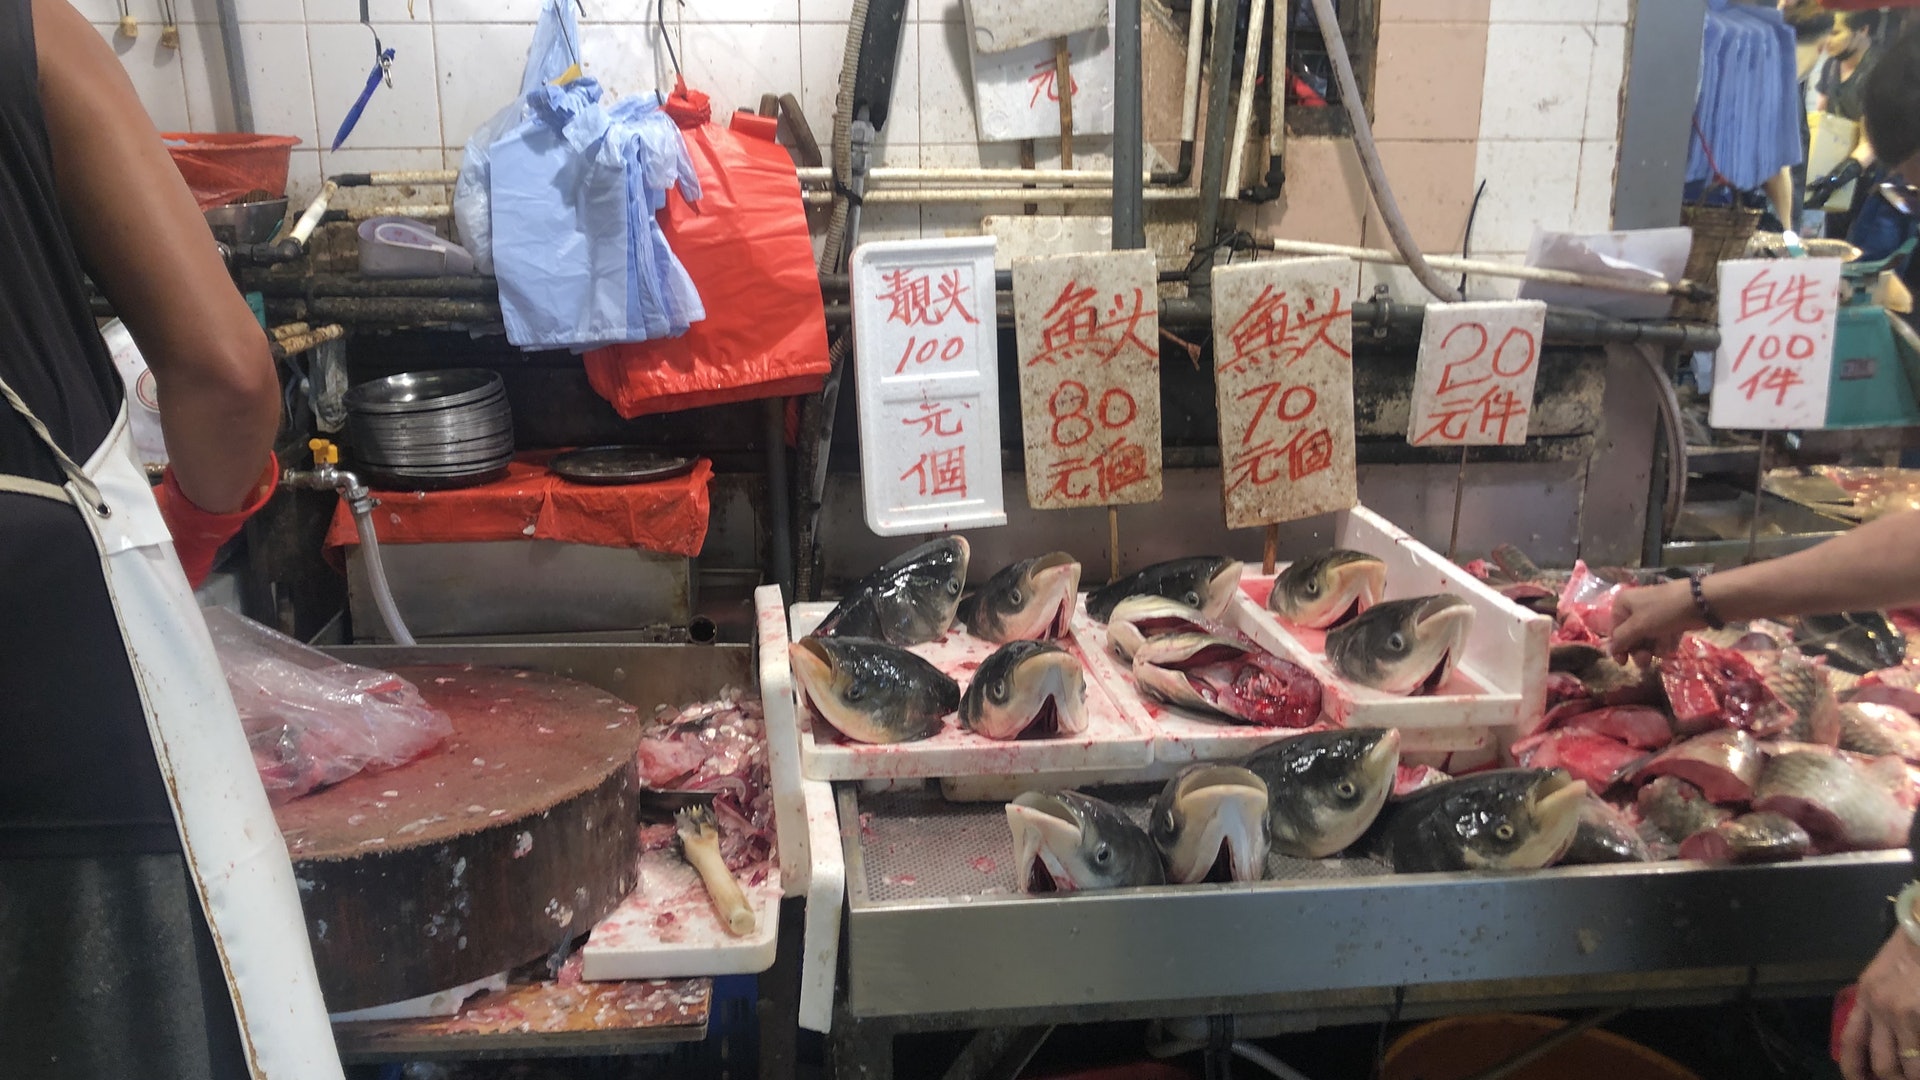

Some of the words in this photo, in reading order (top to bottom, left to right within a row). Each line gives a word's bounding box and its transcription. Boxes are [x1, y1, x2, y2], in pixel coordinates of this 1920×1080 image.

[894, 336, 965, 374] 100
[1436, 322, 1535, 396] 20
[1732, 334, 1815, 373] 100
[1237, 381, 1317, 444] 70
[1737, 366, 1804, 406] 件
[902, 402, 963, 436] 元
[1048, 381, 1136, 447] 80
[1415, 385, 1527, 445] 元件
[900, 445, 968, 498] 個
